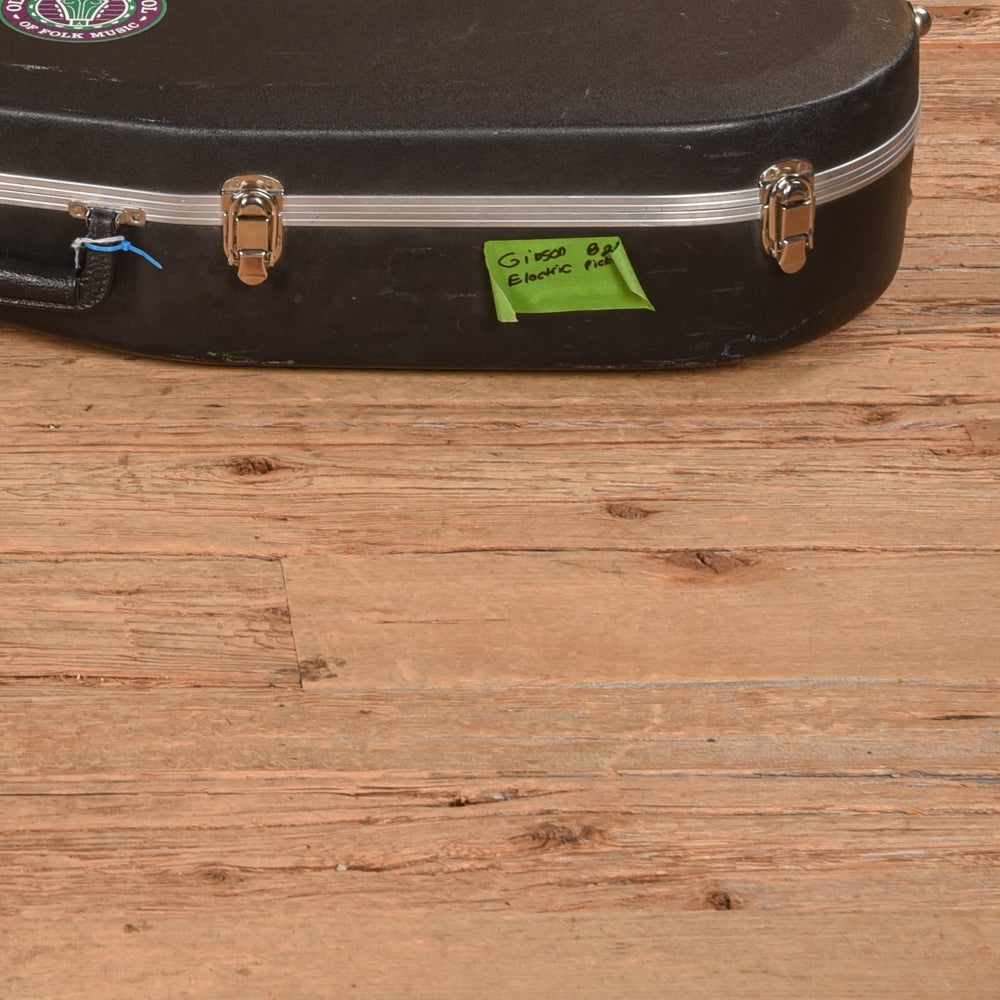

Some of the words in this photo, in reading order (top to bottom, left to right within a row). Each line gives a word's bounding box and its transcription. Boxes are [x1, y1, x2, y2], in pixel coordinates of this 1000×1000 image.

[19, 20, 39, 31] OF
[38, 27, 84, 39] FOLK
[89, 22, 140, 39] MUSIC
[497, 246, 567, 269] Gibson
[507, 263, 572, 287] Electric
